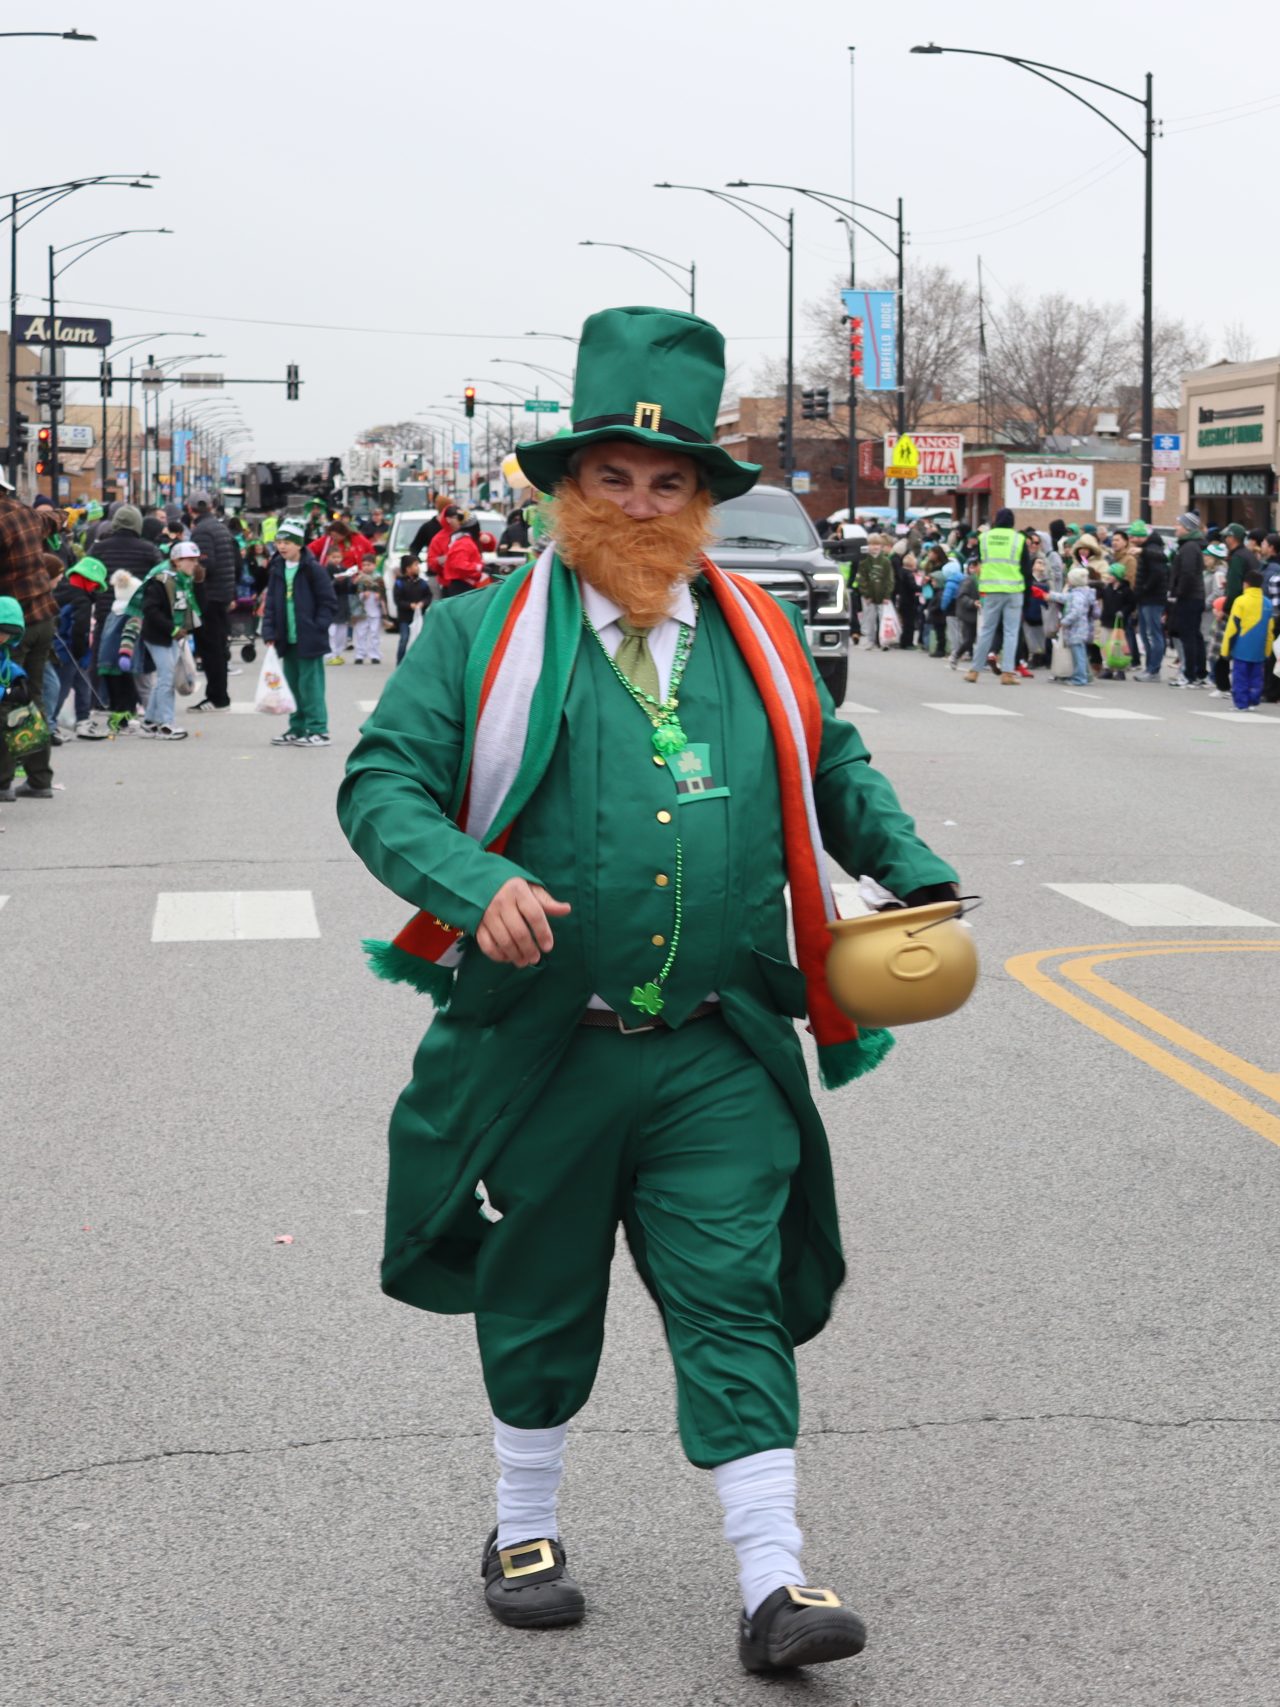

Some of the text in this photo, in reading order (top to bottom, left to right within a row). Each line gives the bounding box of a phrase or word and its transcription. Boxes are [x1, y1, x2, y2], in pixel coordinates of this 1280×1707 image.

[881, 302, 892, 380] GARFIELD RIDGE
[887, 436, 959, 448] UANOS
[918, 451, 957, 474] IZZA
[1020, 487, 1080, 500] PIZZA
